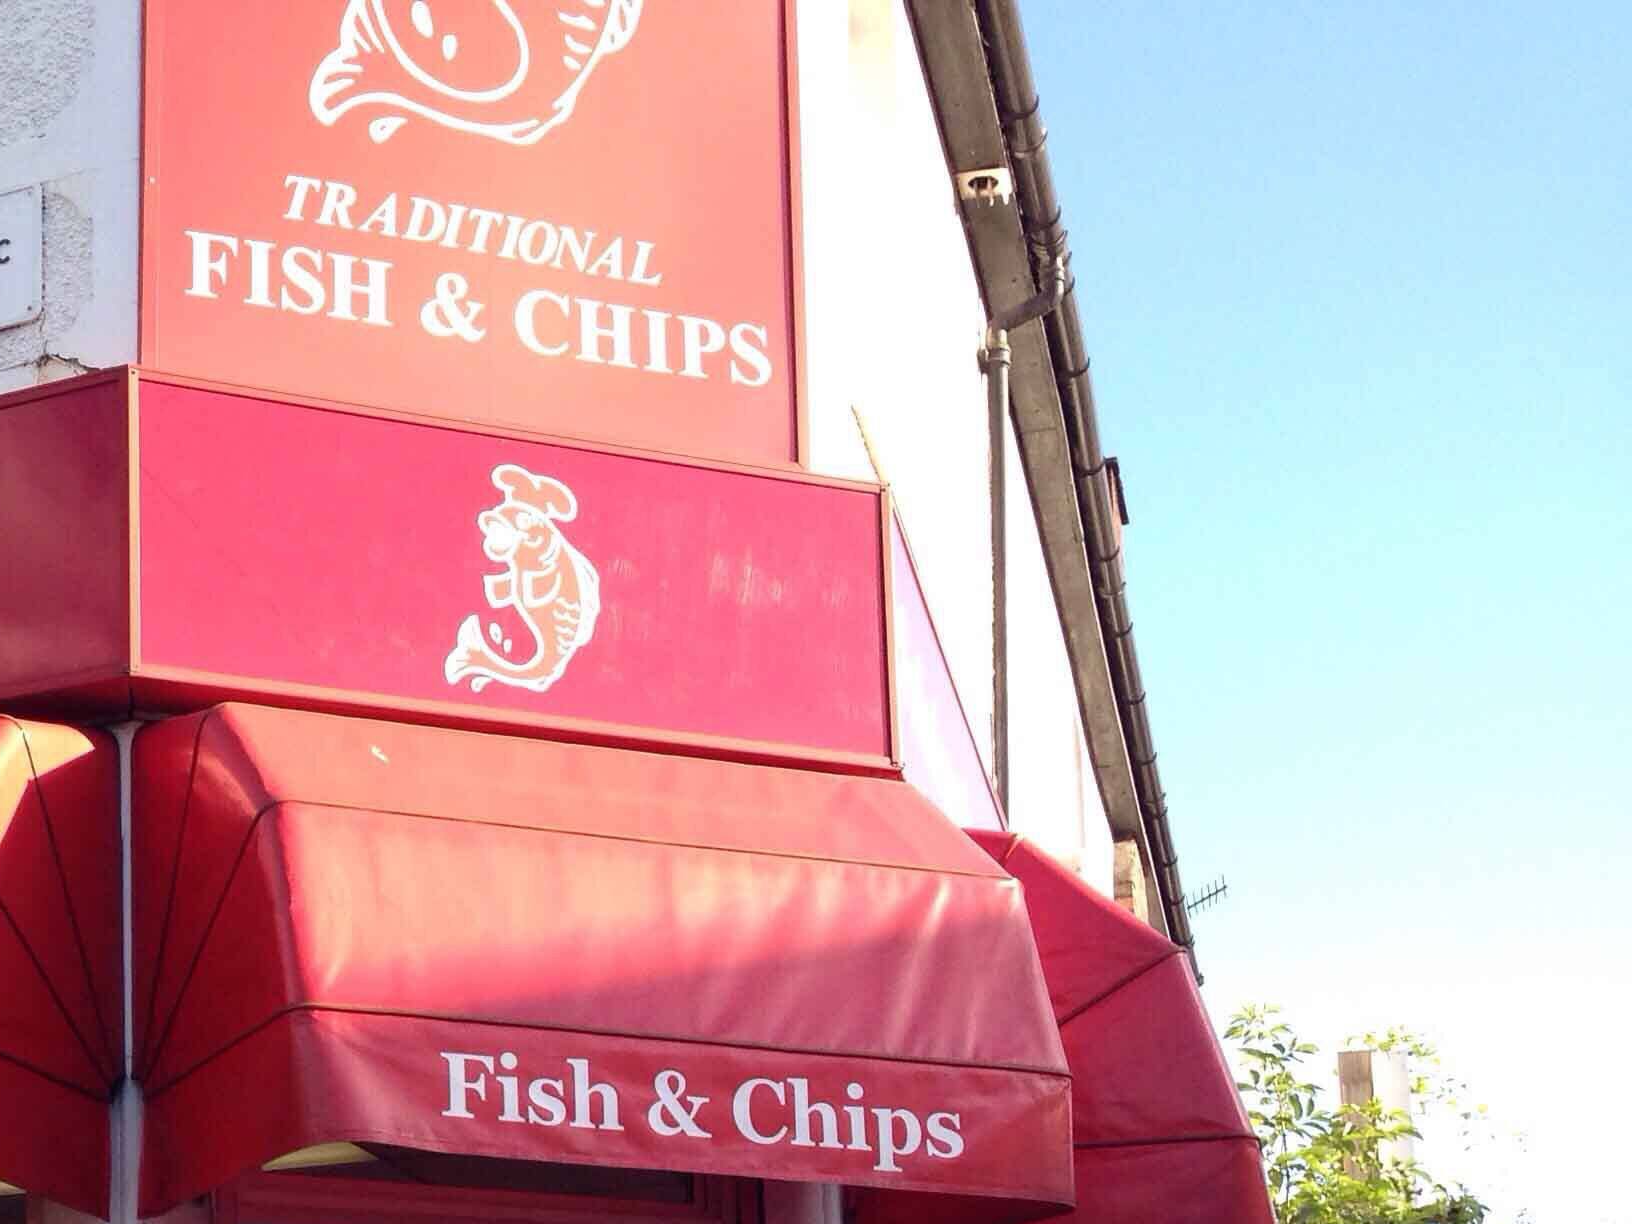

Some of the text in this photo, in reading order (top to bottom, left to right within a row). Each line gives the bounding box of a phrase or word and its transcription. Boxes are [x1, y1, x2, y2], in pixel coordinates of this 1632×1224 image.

[284, 174, 662, 287] TRADITIONAL
[184, 229, 773, 388] FISH & CHIPS
[440, 1051, 966, 1173] Fish & Chips
